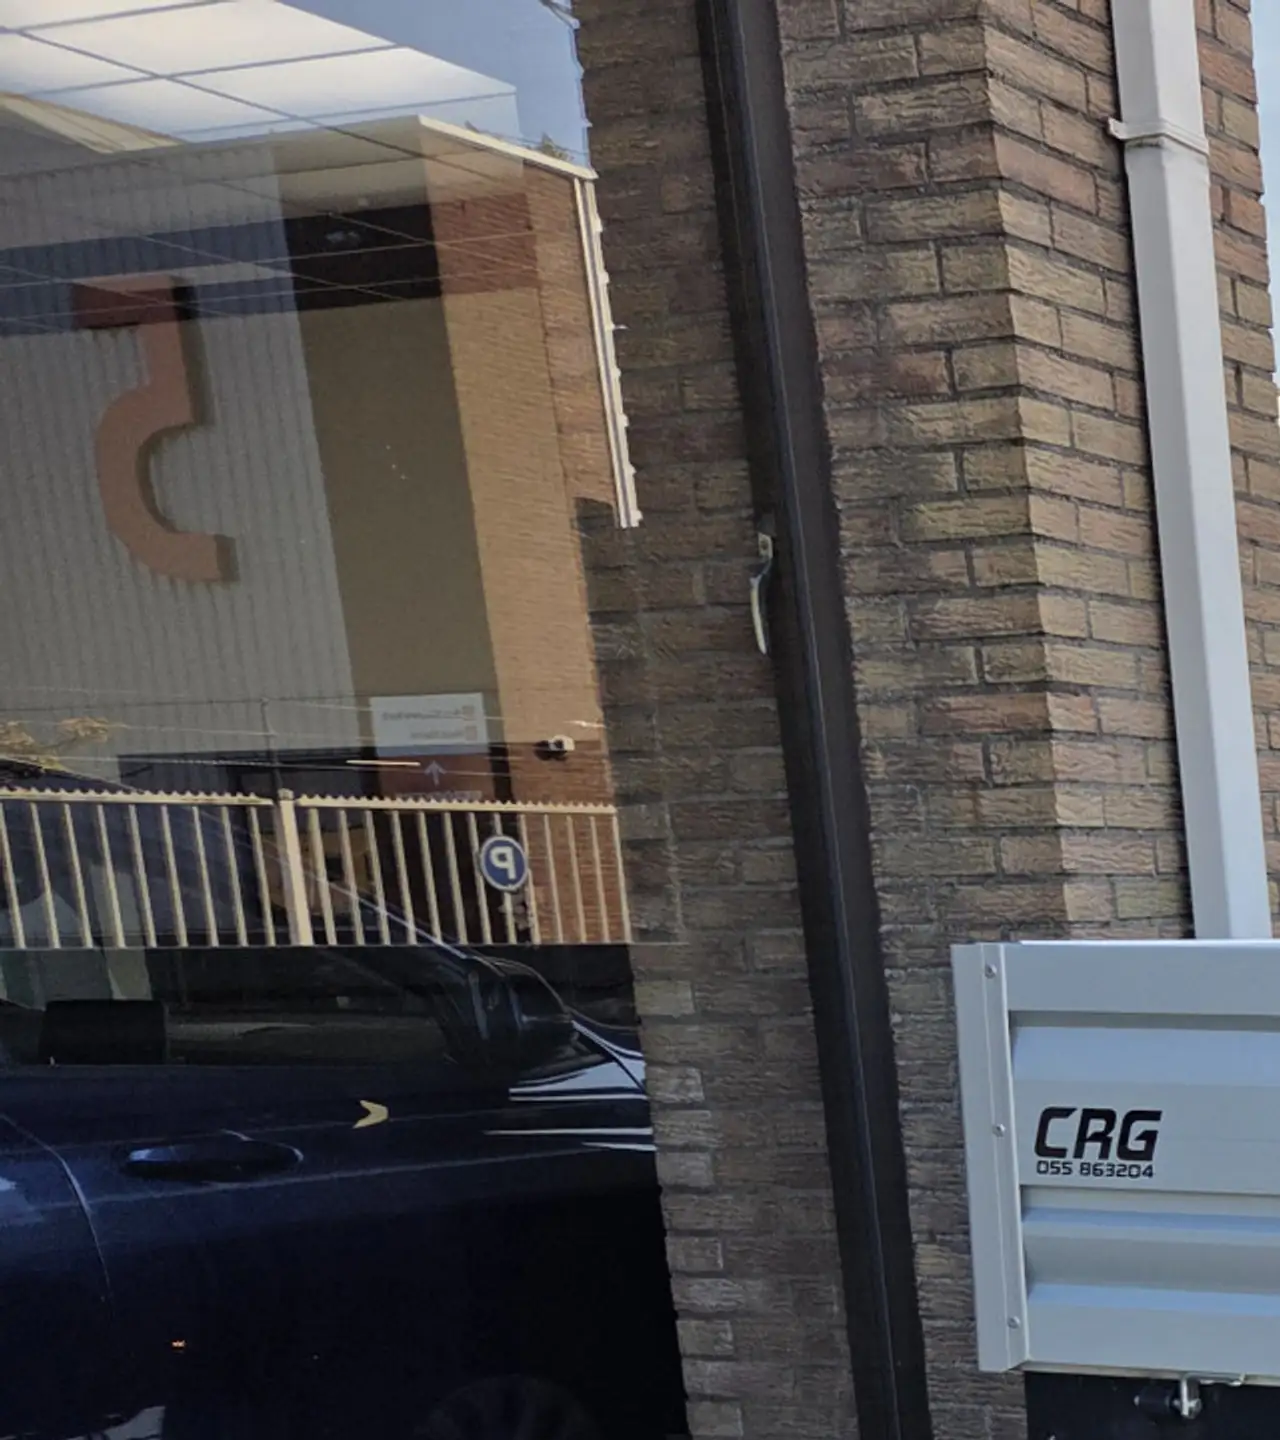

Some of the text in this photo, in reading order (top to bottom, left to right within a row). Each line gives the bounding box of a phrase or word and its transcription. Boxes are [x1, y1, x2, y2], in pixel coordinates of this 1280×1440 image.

[1034, 1106, 1163, 1162] CRG
[1036, 1160, 1154, 1179] 055 863204
